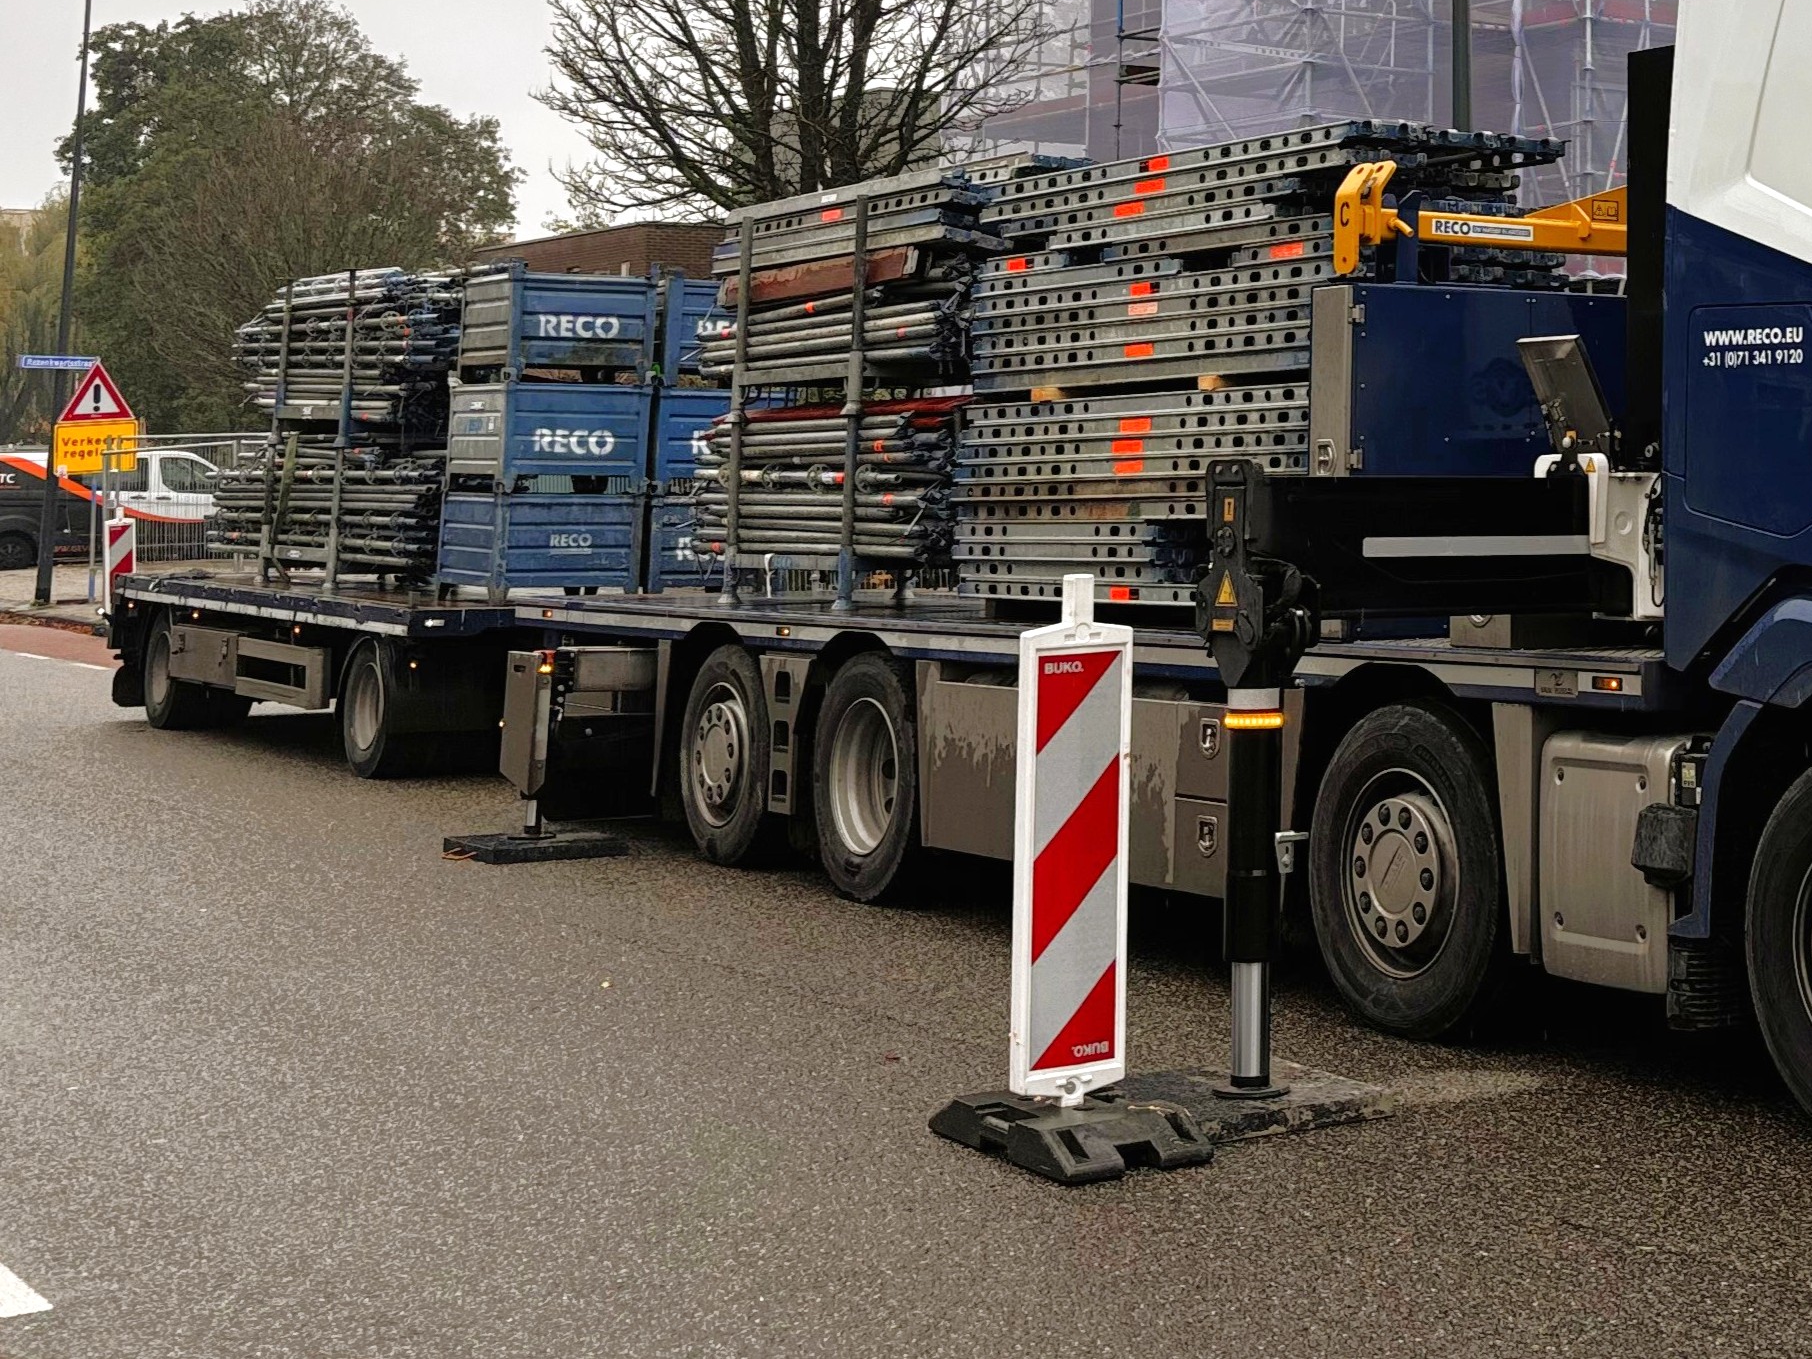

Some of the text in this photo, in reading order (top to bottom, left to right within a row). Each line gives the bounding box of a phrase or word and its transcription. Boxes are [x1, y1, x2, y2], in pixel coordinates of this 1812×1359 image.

[1433, 219, 1471, 236] RECO
[539, 313, 620, 339] RECO
[1703, 326, 1804, 347] WWW.RECO.EU
[1702, 348, 1804, 369] +31 (0)71 341 9120
[532, 427, 615, 456] RECO
[550, 532, 593, 548] RECO
